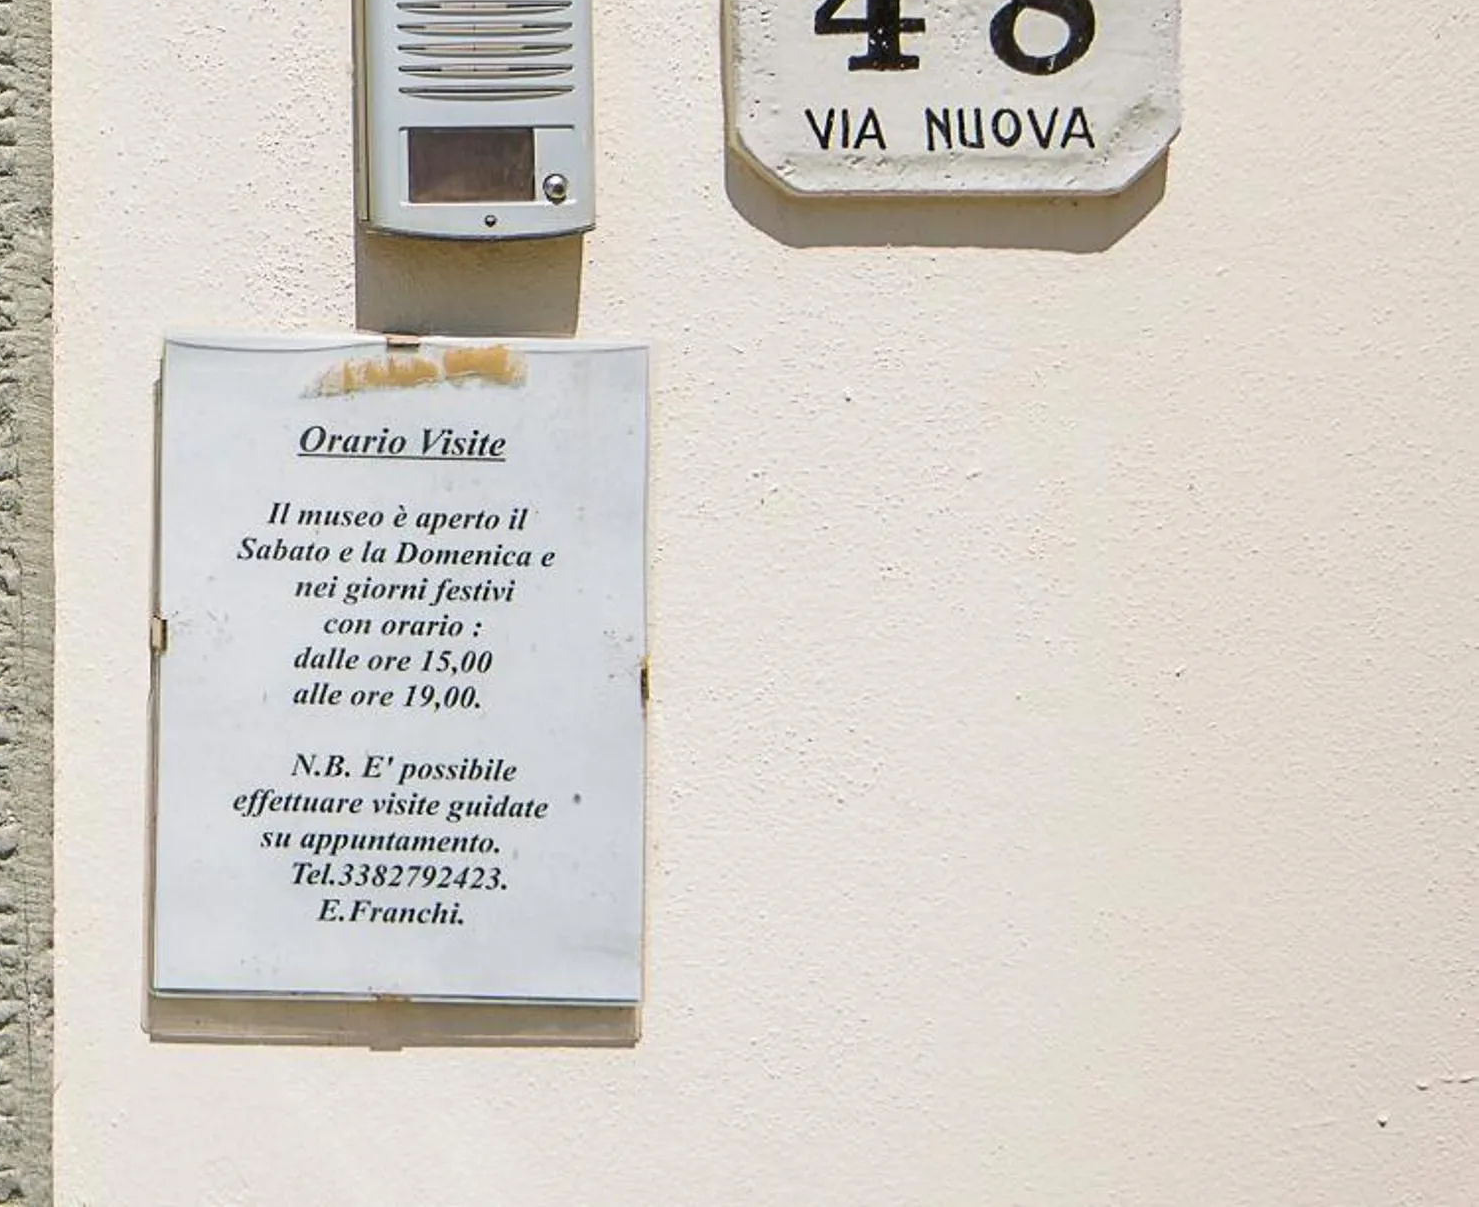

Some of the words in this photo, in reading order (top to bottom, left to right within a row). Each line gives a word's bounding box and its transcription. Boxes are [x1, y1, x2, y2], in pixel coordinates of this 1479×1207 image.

[804, 107, 887, 151] VIA
[924, 106, 1096, 152] NUOVA
[297, 425, 409, 458] Orario
[418, 428, 507, 461] Visite
[267, 502, 291, 525] Il
[297, 509, 384, 528] museo
[393, 504, 408, 528] è
[415, 510, 501, 536] aperto
[508, 507, 529, 531] il
[236, 537, 331, 562] Sabato
[338, 546, 354, 563] e
[361, 540, 387, 564] la
[394, 541, 533, 568] Domenica
[540, 551, 556, 568] e
[294, 577, 339, 599] nei
[342, 577, 429, 605] giorni
[428, 577, 516, 607] festivi
[323, 618, 372, 635] con
[380, 615, 464, 637] orario
[293, 646, 360, 670] dalle
[367, 654, 412, 672] ore
[421, 649, 493, 676] 15,00
[292, 681, 343, 706] alle
[350, 689, 394, 707] ore
[403, 684, 481, 711] 19,00.
[291, 753, 351, 778] N.B.
[361, 755, 394, 779] E'
[397, 757, 518, 785] possibile
[232, 788, 364, 818] effettuare
[372, 794, 441, 816] visite
[445, 795, 549, 824] guidate
[260, 831, 292, 849] su
[299, 832, 500, 857] appuntamento.
[292, 861, 508, 891] Tel.3382792423.
[318, 898, 464, 926] E.Franchi.
